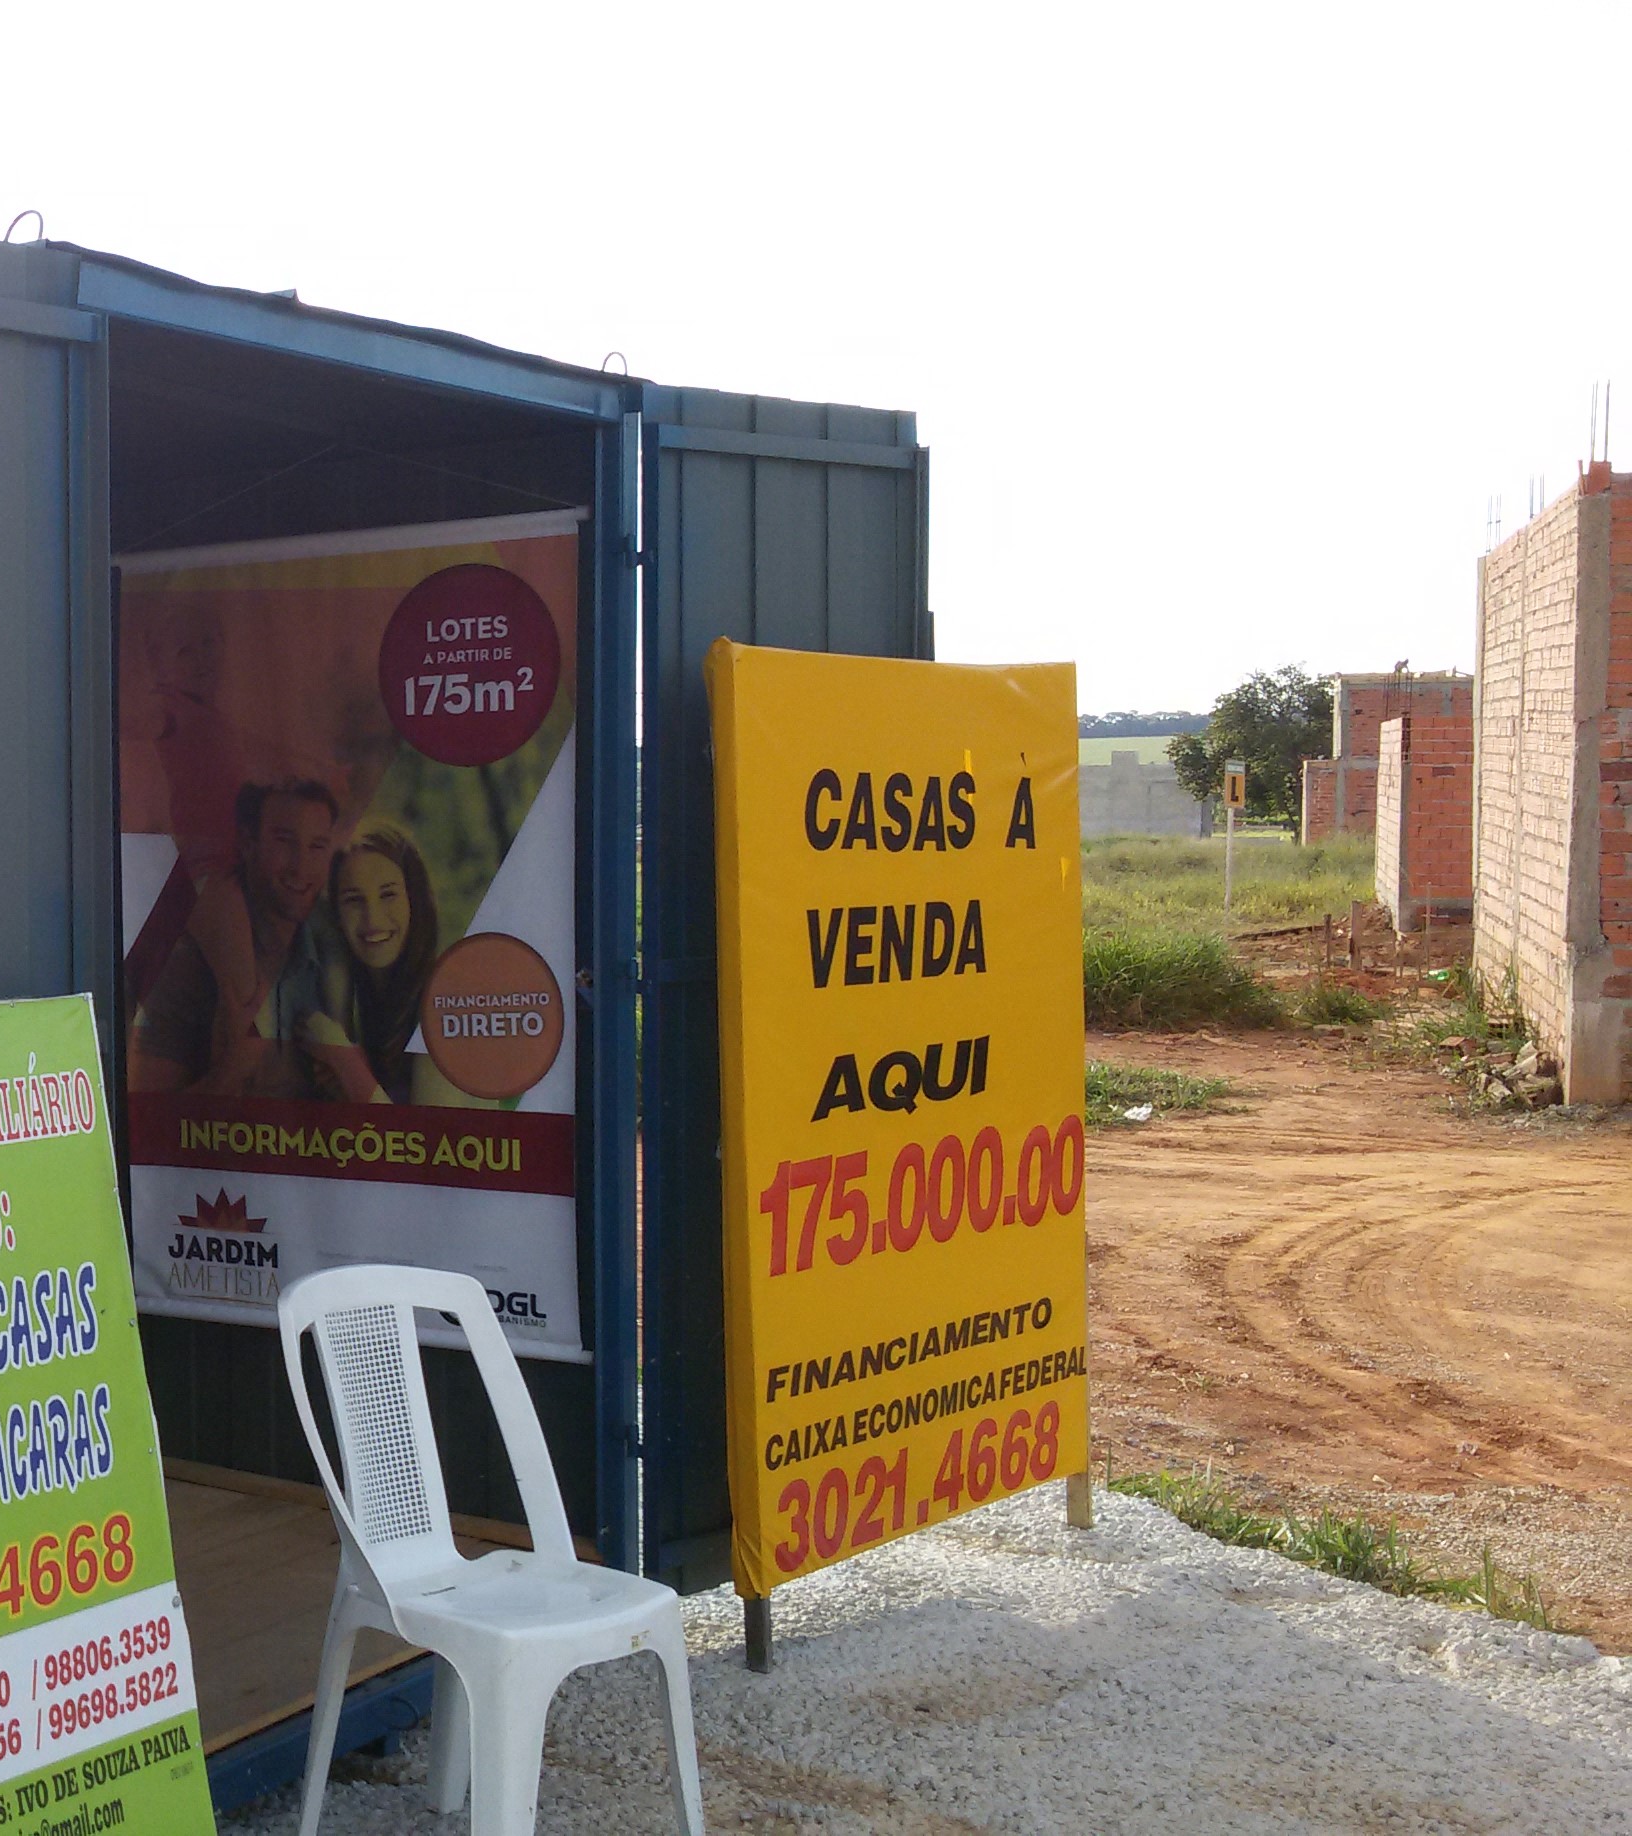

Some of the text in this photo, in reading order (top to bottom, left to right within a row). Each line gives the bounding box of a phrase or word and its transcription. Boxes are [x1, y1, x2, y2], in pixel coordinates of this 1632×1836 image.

[423, 647, 512, 664] A PARTIR DE
[426, 615, 509, 643] LOTES
[805, 752, 1036, 852] CASAS À
[806, 899, 987, 989] VENDA
[433, 992, 550, 1009] FINANCIAMENTO
[442, 1012, 545, 1039] DIRETO
[810, 1034, 990, 1122] AQUI
[180, 1118, 522, 1173] INFORMAÇÕES AQUI
[760, 1114, 1085, 1278] 175.000.00
[168, 1233, 279, 1269] JARDIM
[168, 1261, 281, 1297] AMETISTA
[495, 1314, 547, 1328] BANISMO
[766, 1297, 1052, 1403] FINANCIAMENTO
[765, 1346, 1086, 1471] CAIXA ECONOMICA FEDERAL
[775, 1400, 1060, 1572] 3021.4668
[15, 1779, 49, 1816] IVO
[52, 1767, 79, 1802] DE
[83, 1744, 138, 1792] SOUZA
[142, 1725, 192, 1767] PAIVA
